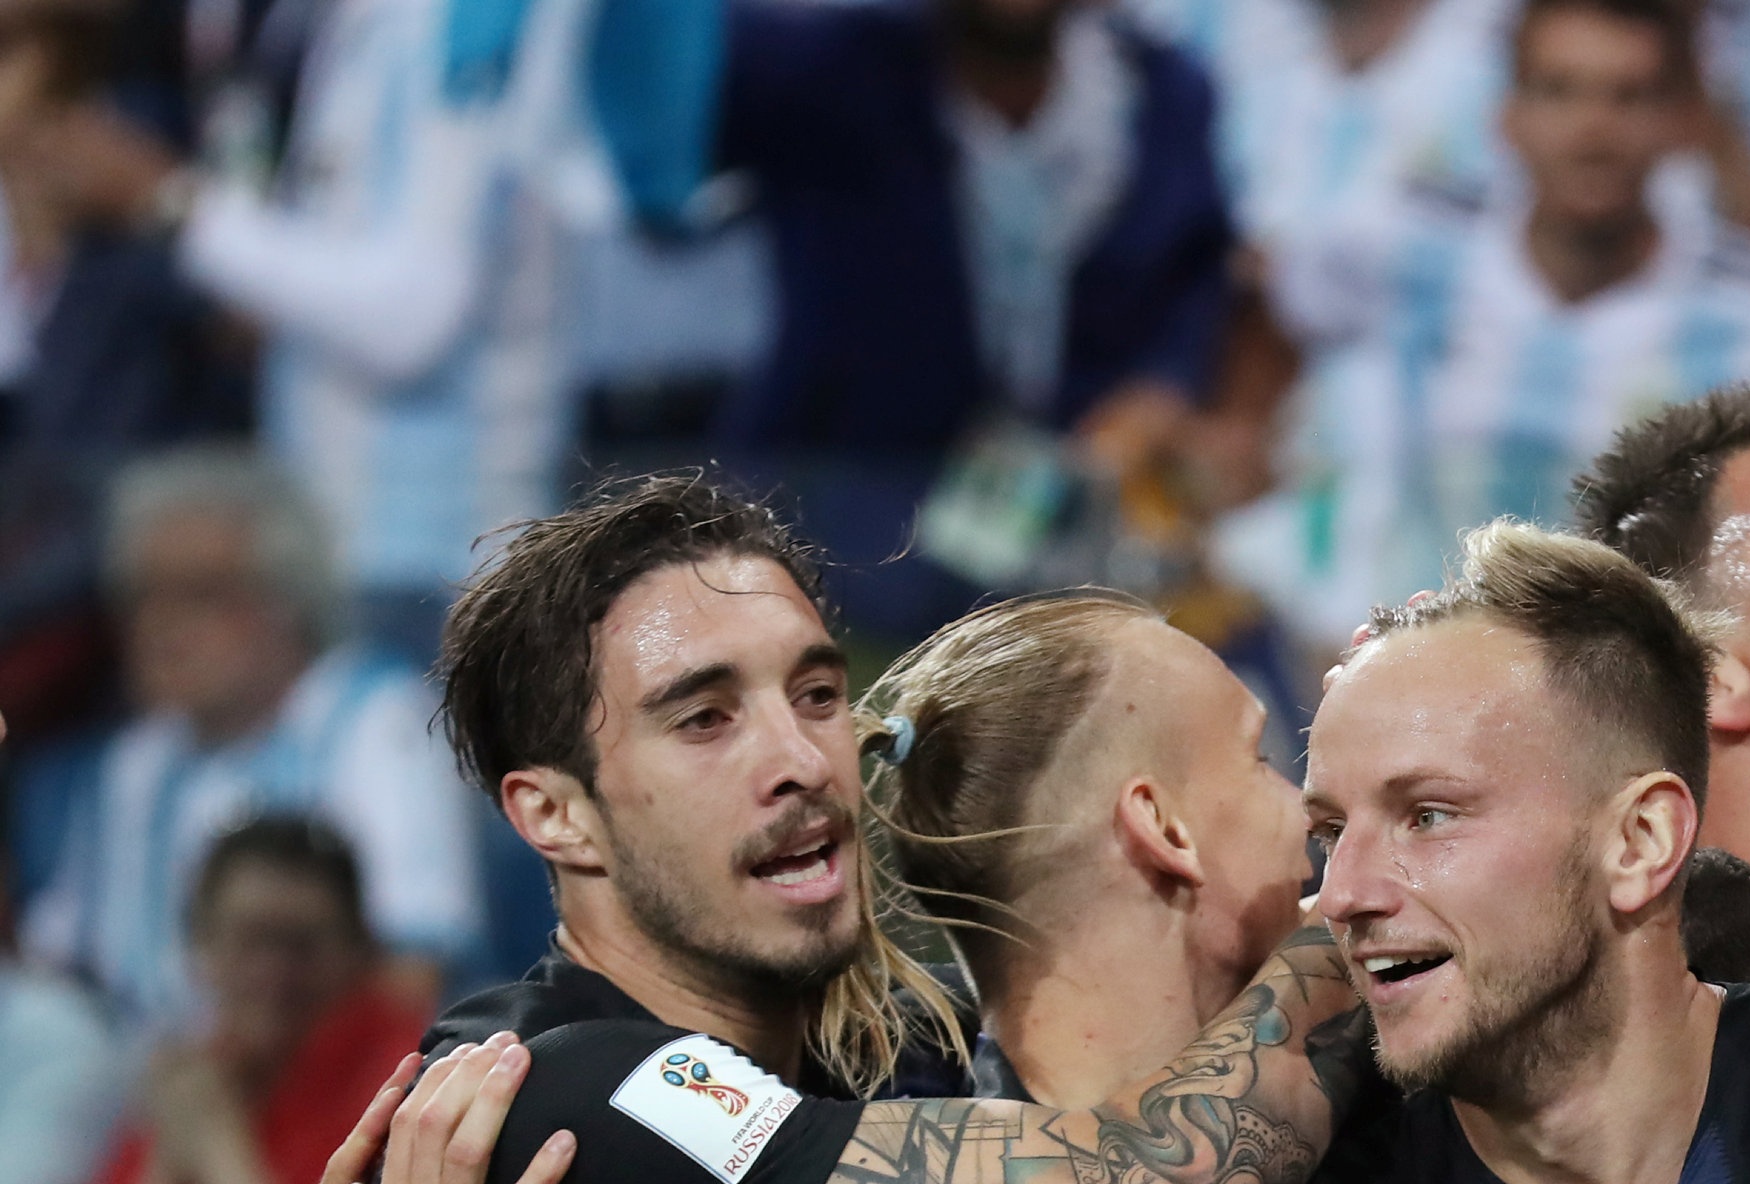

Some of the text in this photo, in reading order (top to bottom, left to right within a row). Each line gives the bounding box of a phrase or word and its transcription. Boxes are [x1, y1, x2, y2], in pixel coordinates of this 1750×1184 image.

[724, 1092, 798, 1175] RUSSIA 2018
[731, 1128, 747, 1144] FIFA
[743, 1104, 766, 1131] WORLD
